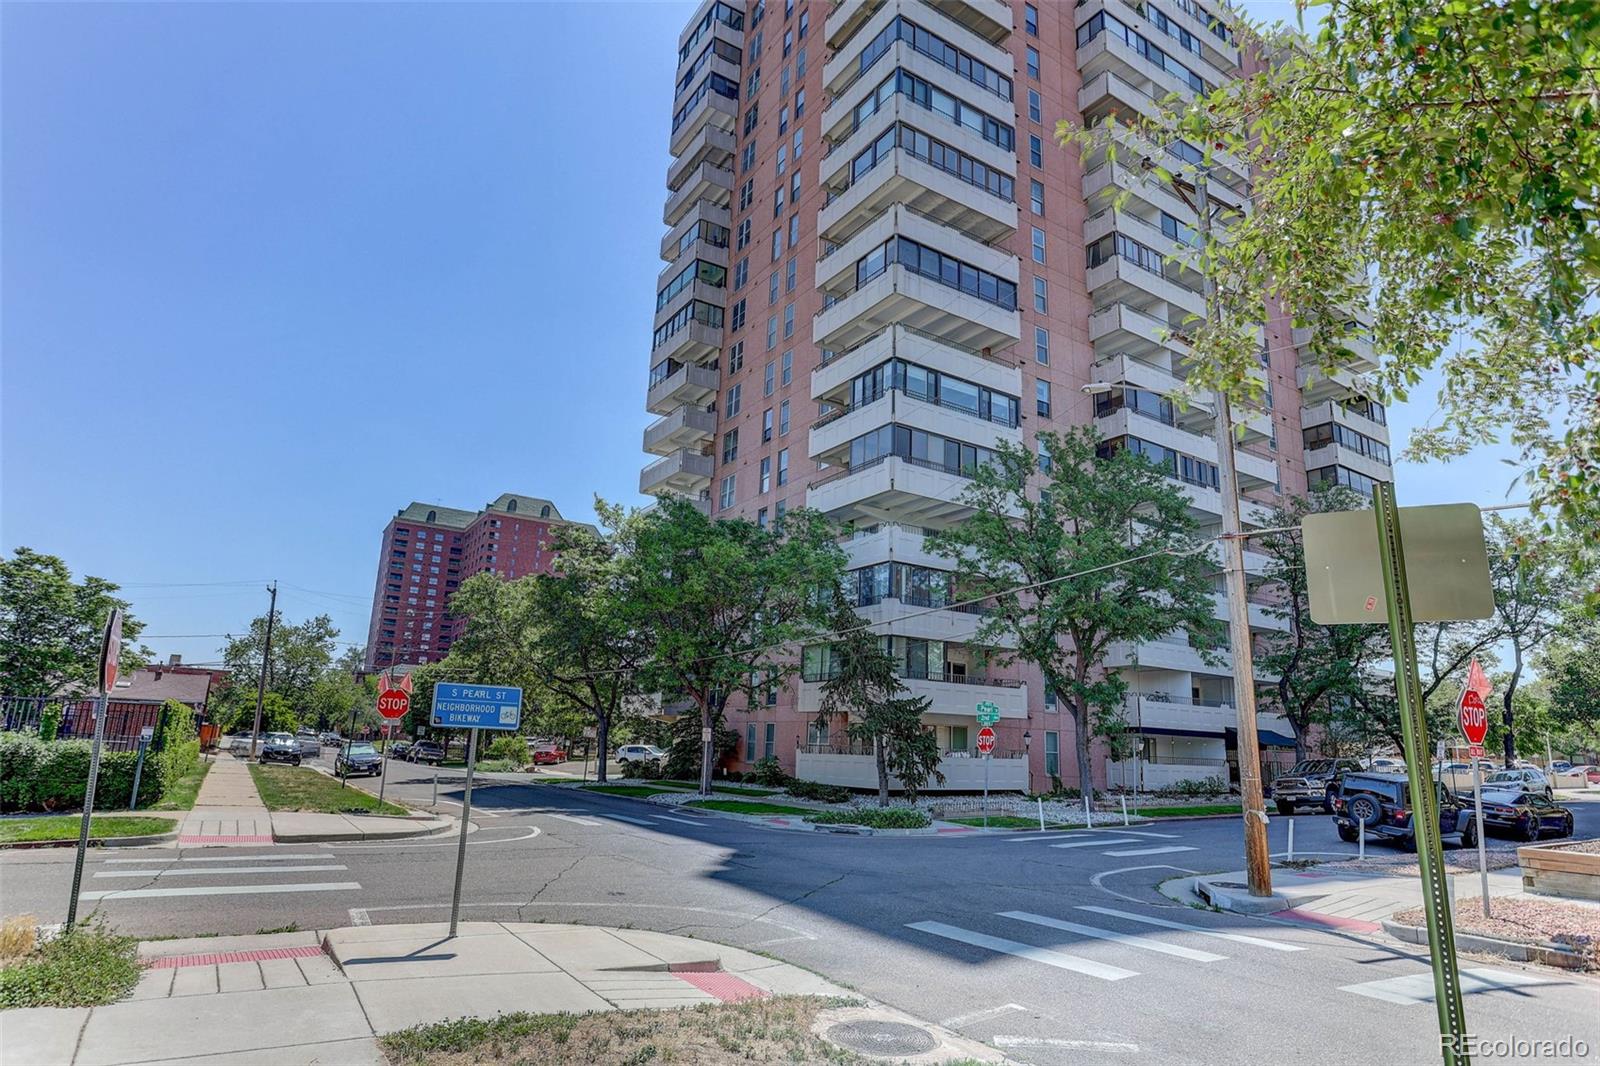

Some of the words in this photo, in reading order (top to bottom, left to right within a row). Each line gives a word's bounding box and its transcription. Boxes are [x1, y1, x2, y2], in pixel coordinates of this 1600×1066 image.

[451, 688, 458, 697] S
[462, 689, 491, 699] PEARL
[495, 691, 507, 700] ST
[379, 697, 408, 711] STOP
[436, 702, 496, 714] NEIGHBORHOOD
[449, 713, 481, 723] BIKEWAY
[1463, 706, 1485, 727] STOP
[978, 735, 995, 746] STOP
